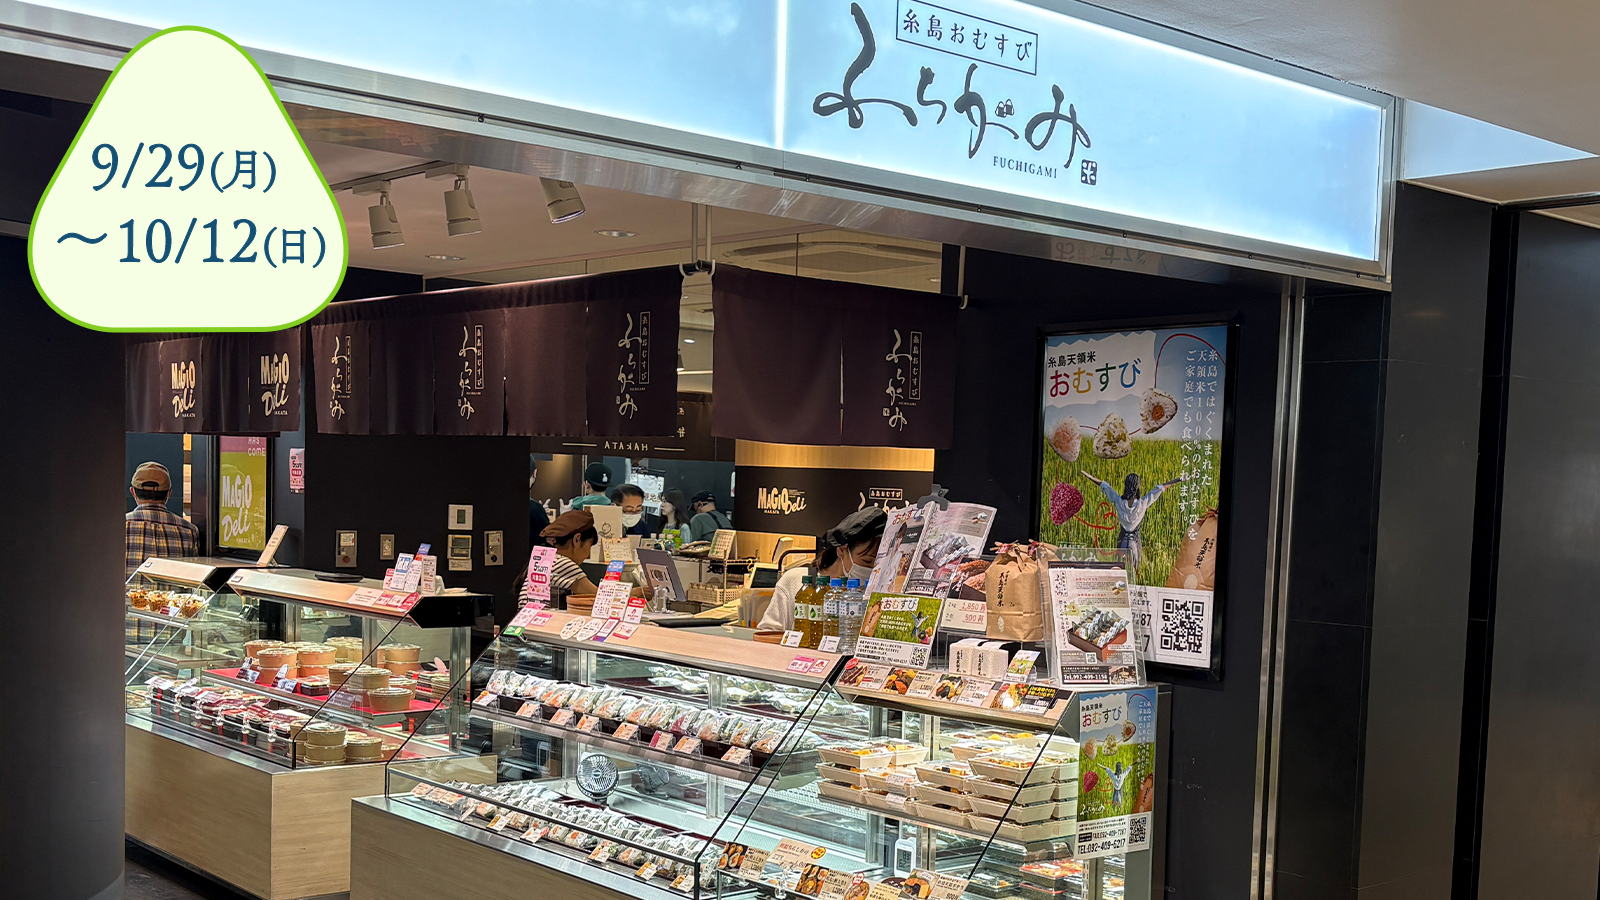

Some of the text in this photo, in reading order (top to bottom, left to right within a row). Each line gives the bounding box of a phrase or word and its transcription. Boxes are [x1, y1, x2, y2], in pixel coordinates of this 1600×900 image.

[903, 8, 1032, 62] 糸島おむすび
[993, 155, 1058, 179] FUCHIGAMI
[1048, 351, 1096, 368] 糸島天領米
[1050, 357, 1142, 397] おむすび
[1082, 706, 1122, 728] おむすび
